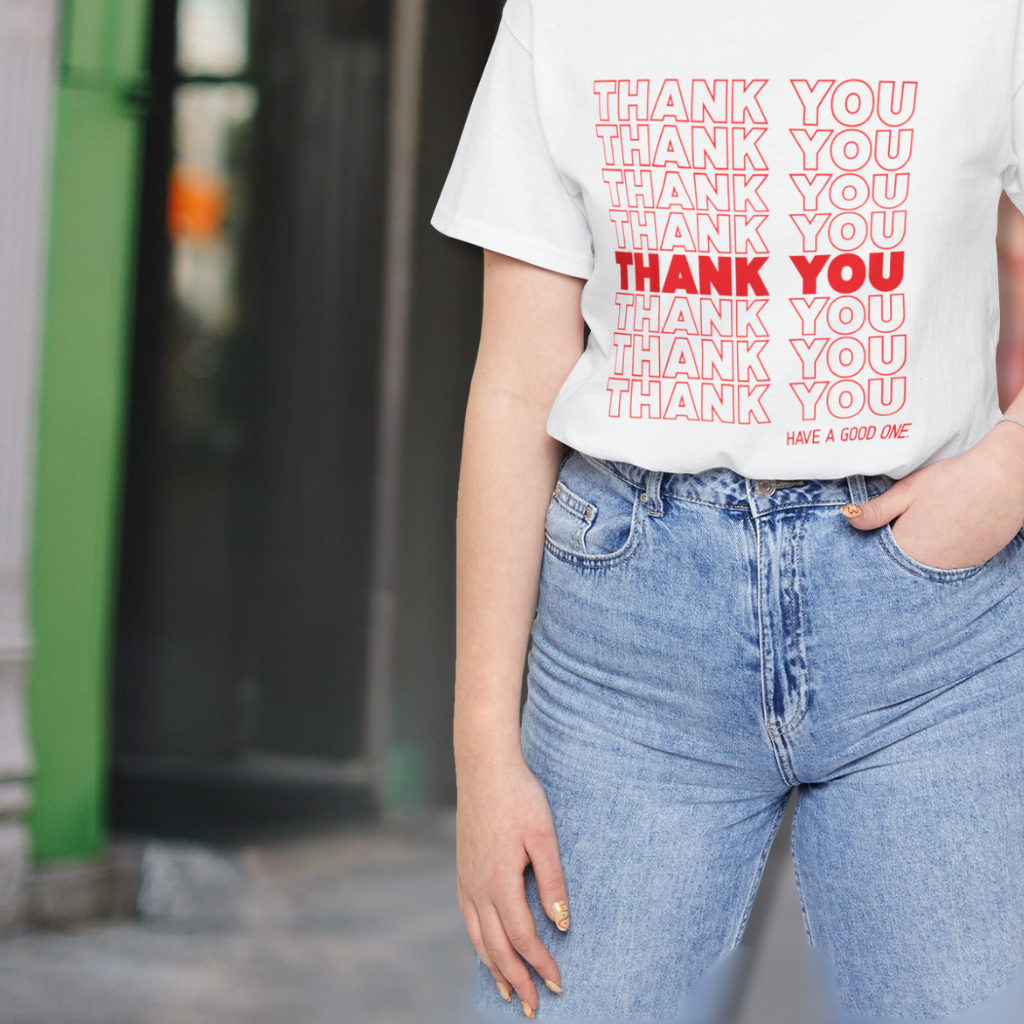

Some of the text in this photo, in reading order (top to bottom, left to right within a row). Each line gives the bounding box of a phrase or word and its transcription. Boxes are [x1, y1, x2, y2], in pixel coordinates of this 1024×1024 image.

[593, 78, 918, 128] THANK YOU
[595, 124, 914, 172] THANK YOU
[601, 168, 910, 213] THANK YOU
[608, 209, 907, 255] THANK YOU
[614, 251, 905, 297] THANK YOU
[615, 292, 906, 338] THANK YOU
[613, 332, 907, 383] THANK YOU
[606, 376, 907, 425] THANK YOU
[786, 429, 821, 446] HAVE
[825, 428, 835, 443] A
[840, 425, 877, 442] GOOD
